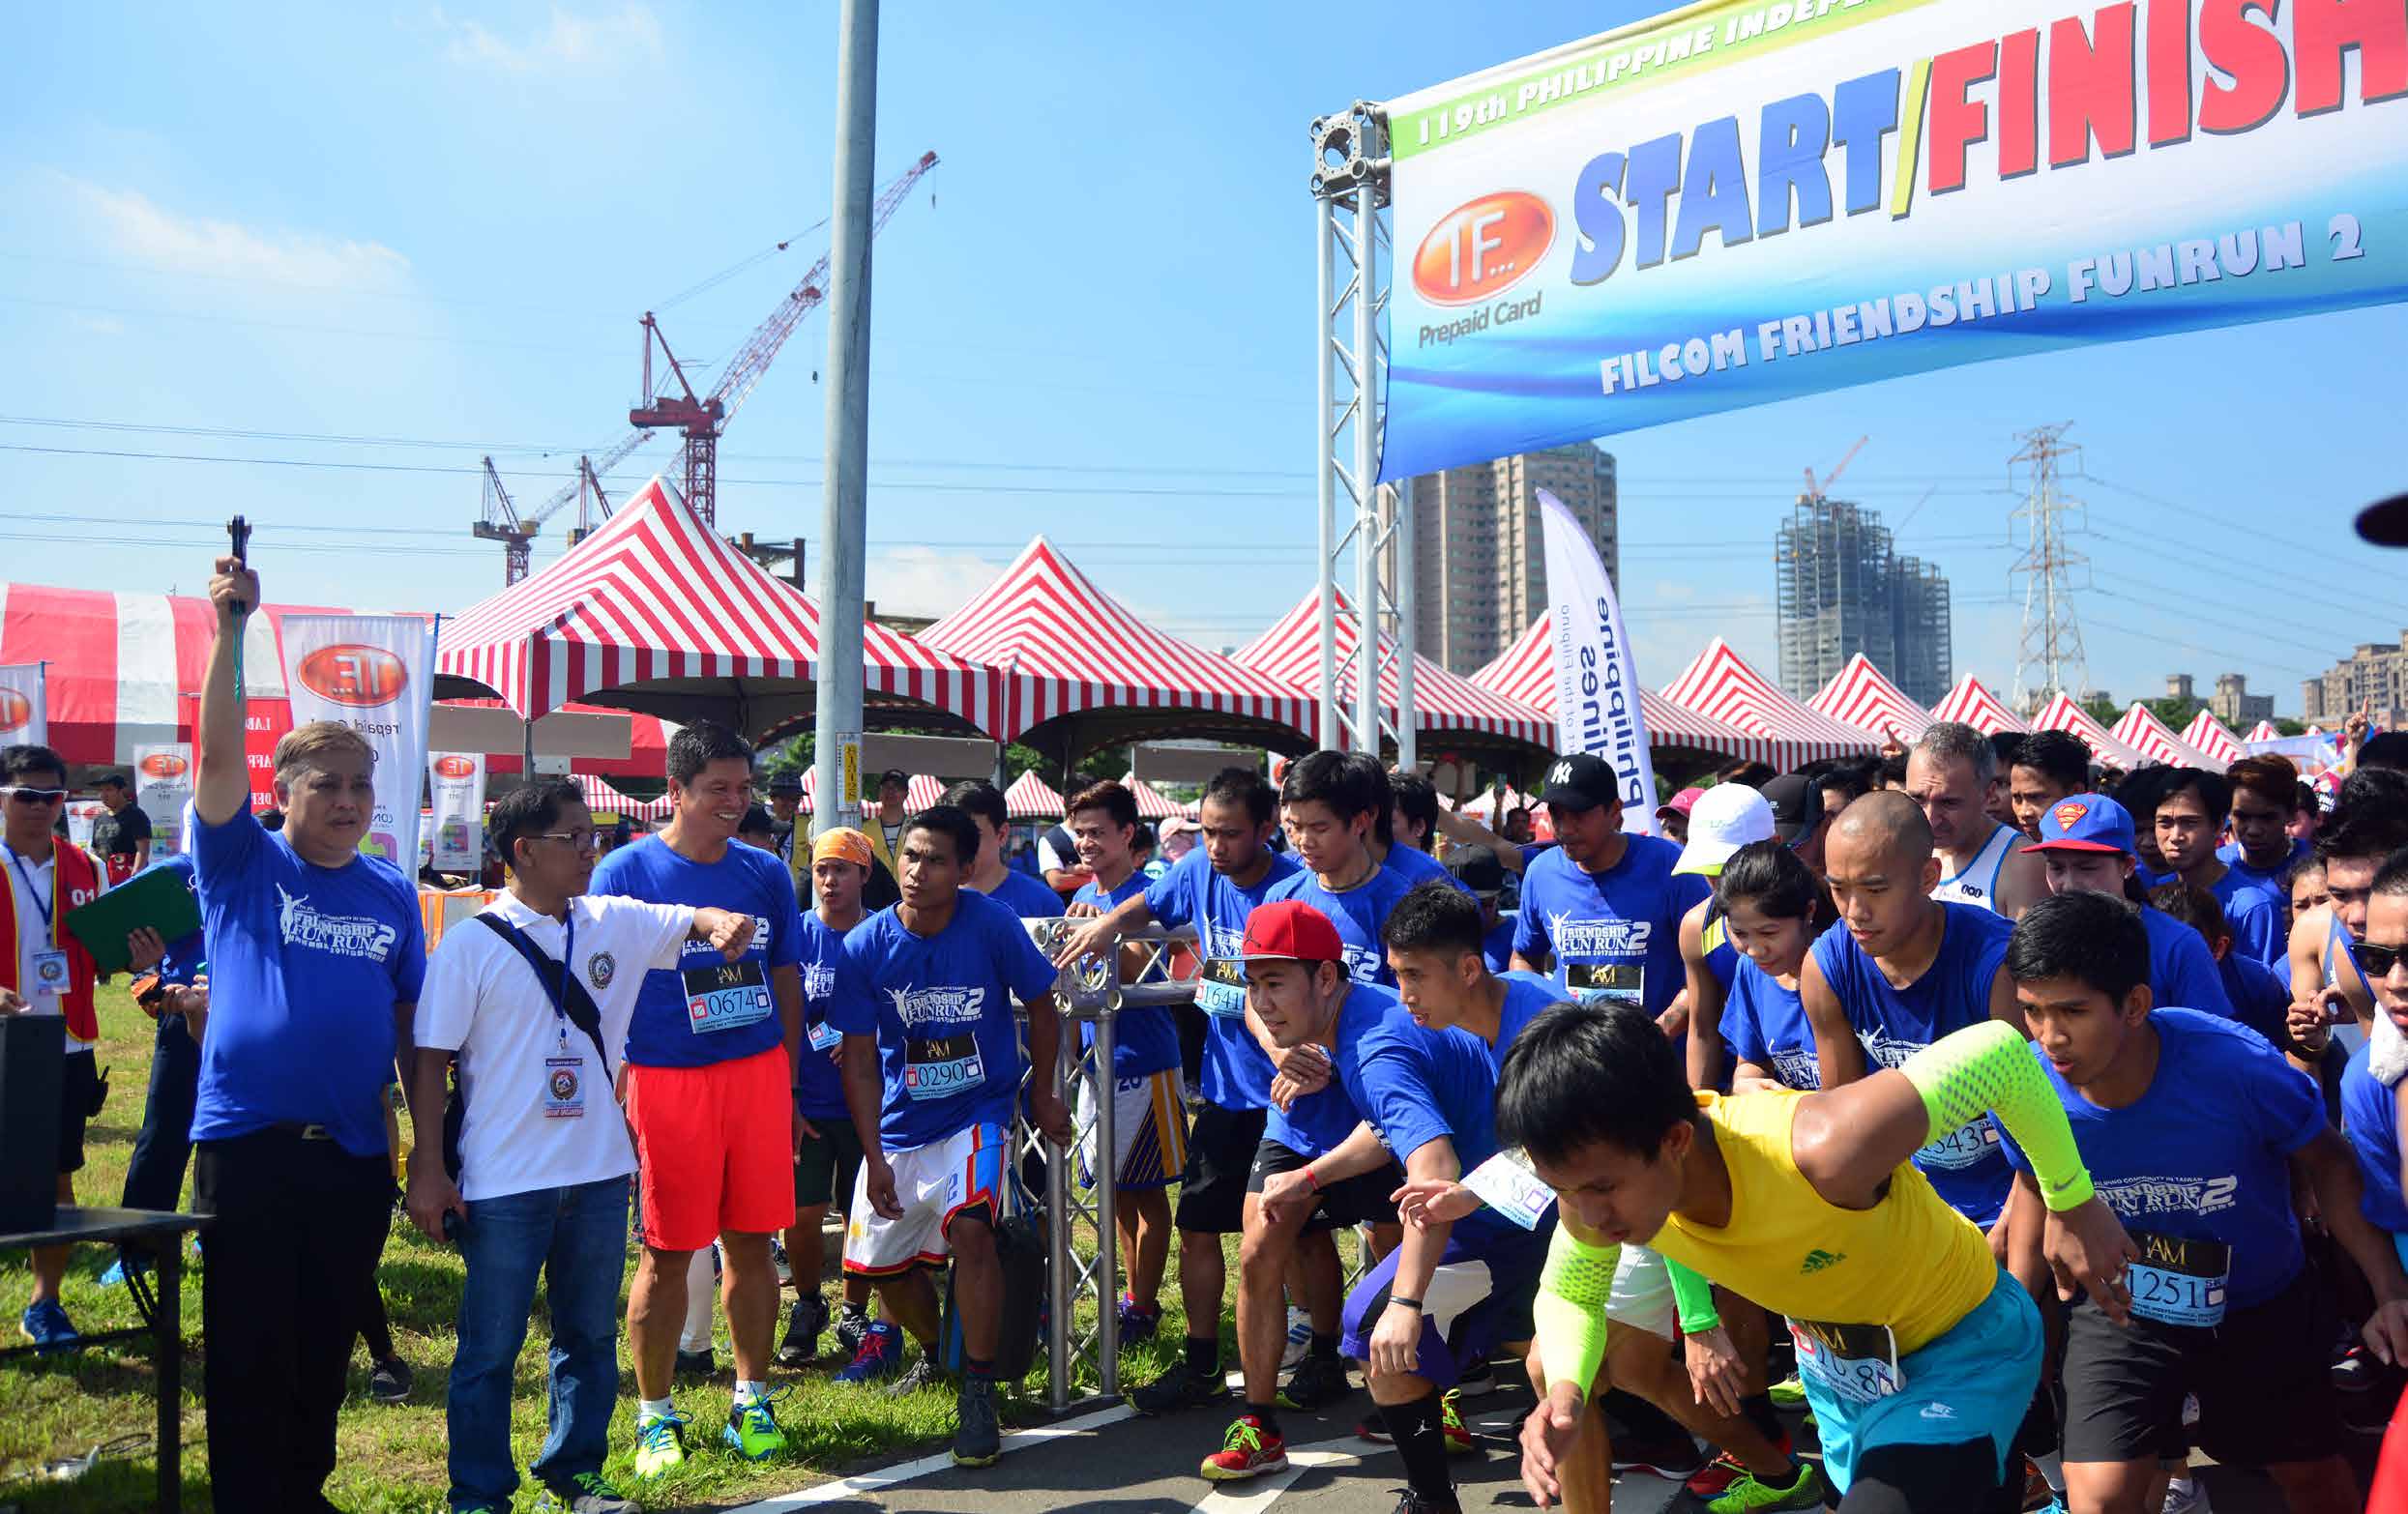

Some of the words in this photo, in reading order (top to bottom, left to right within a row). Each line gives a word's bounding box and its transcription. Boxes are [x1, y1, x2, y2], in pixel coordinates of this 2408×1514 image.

[1419, 93, 1508, 145] 119th
[1515, 23, 1718, 113] PHILIPPINE
[1724, 0, 1873, 46] INDEP
[1419, 306, 1490, 348] Prepaid
[1493, 290, 1542, 326] Card
[1600, 328, 1748, 395] FILCOM
[1757, 268, 2052, 362] FRIENDSHIP
[2067, 219, 2306, 303] FUNRUN
[2327, 213, 2365, 262] 2
[332, 933, 374, 951] RUN
[370, 923, 396, 956] 2
[1562, 926, 1630, 939] FRIENDSHIP
[1562, 938, 1592, 951] FUN
[1595, 938, 1629, 950] RUN
[1628, 921, 1652, 950] 2
[708, 989, 756, 1016] 0674
[963, 986, 985, 1016] 2
[1204, 986, 1240, 1010] 1641
[918, 1063, 965, 1088] 0290
[2096, 1182, 2201, 1201] RIENDSHIP
[2147, 1193, 2200, 1210] RUN
[2200, 1175, 2238, 1208] 2
[2129, 1268, 2199, 1308] 1251
